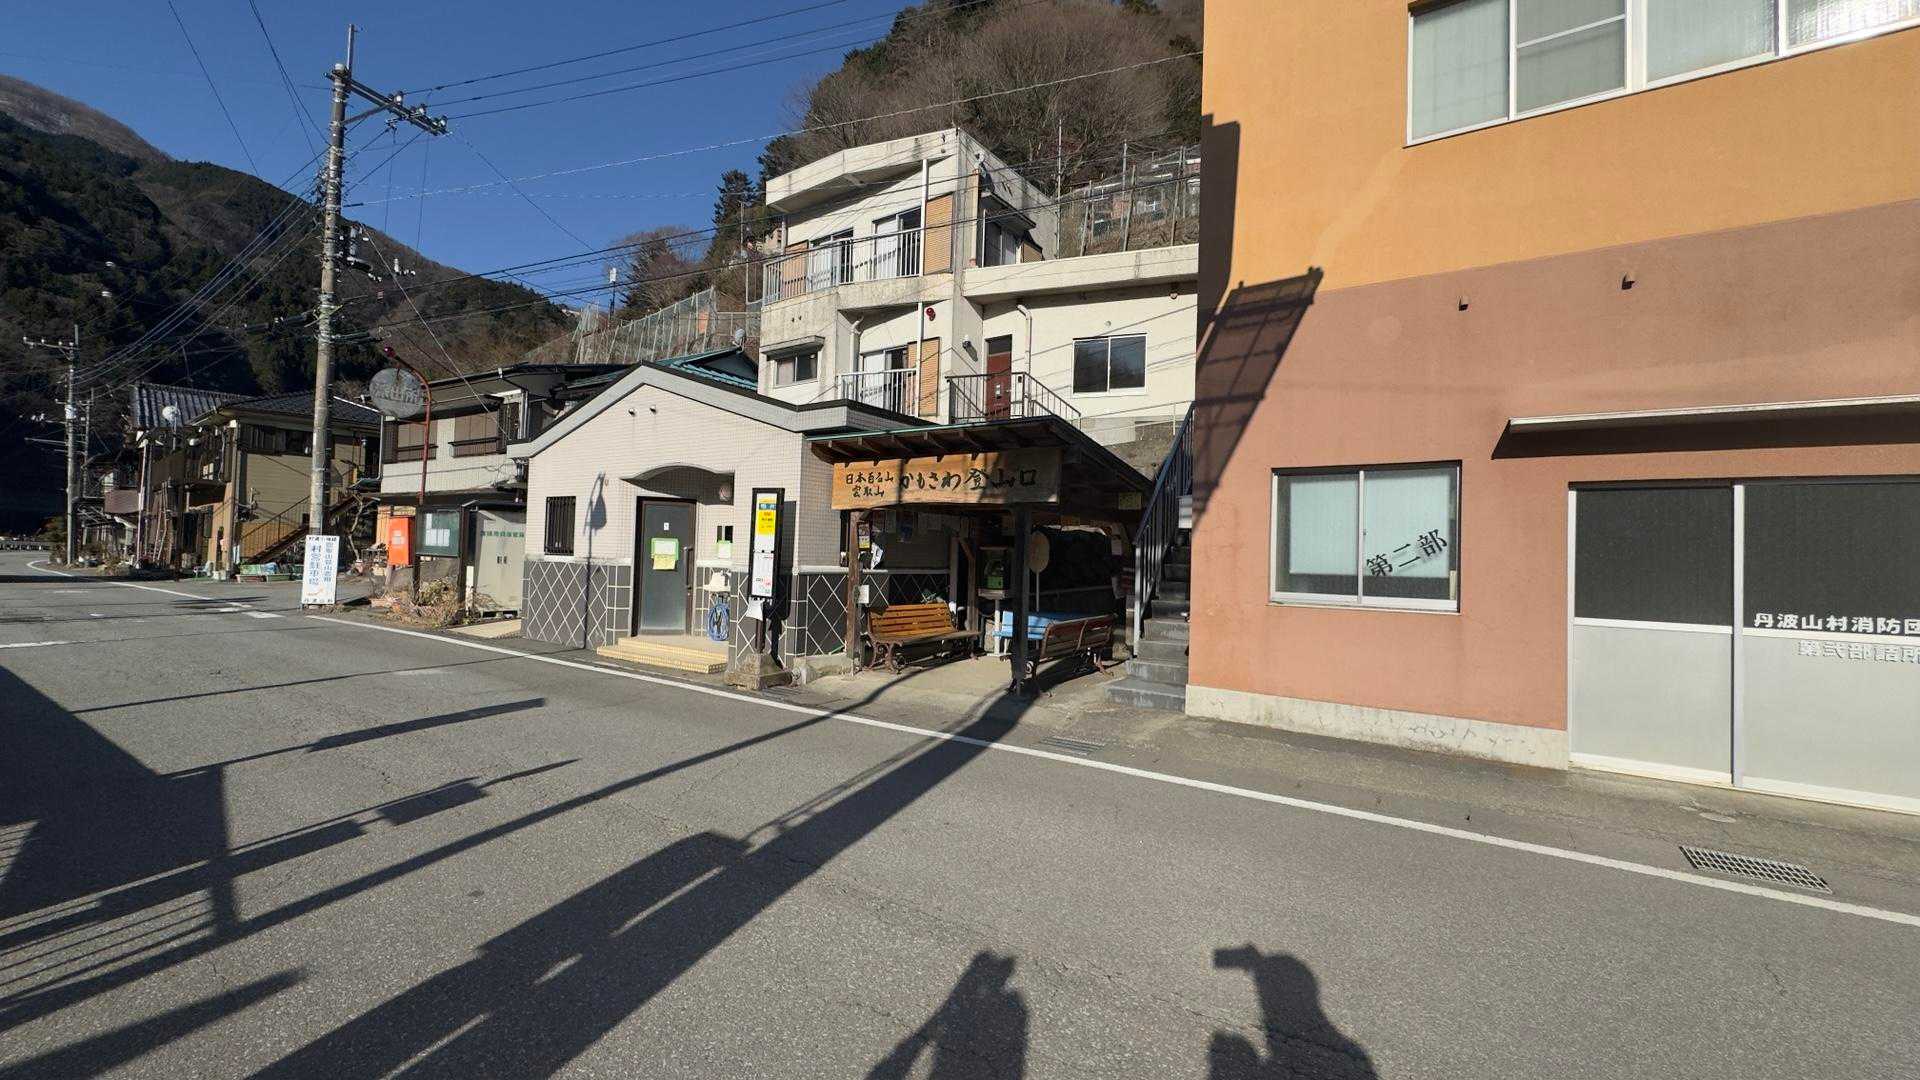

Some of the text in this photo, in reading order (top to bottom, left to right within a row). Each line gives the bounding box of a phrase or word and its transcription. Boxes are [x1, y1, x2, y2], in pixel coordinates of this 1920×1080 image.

[845, 471, 894, 485] 日本百名山
[899, 467, 1037, 492] かもさわ登山口
[851, 486, 885, 498] 雲取山
[1366, 528, 1448, 577] 第二部
[1753, 612, 1920, 636] 丹波山村消防団
